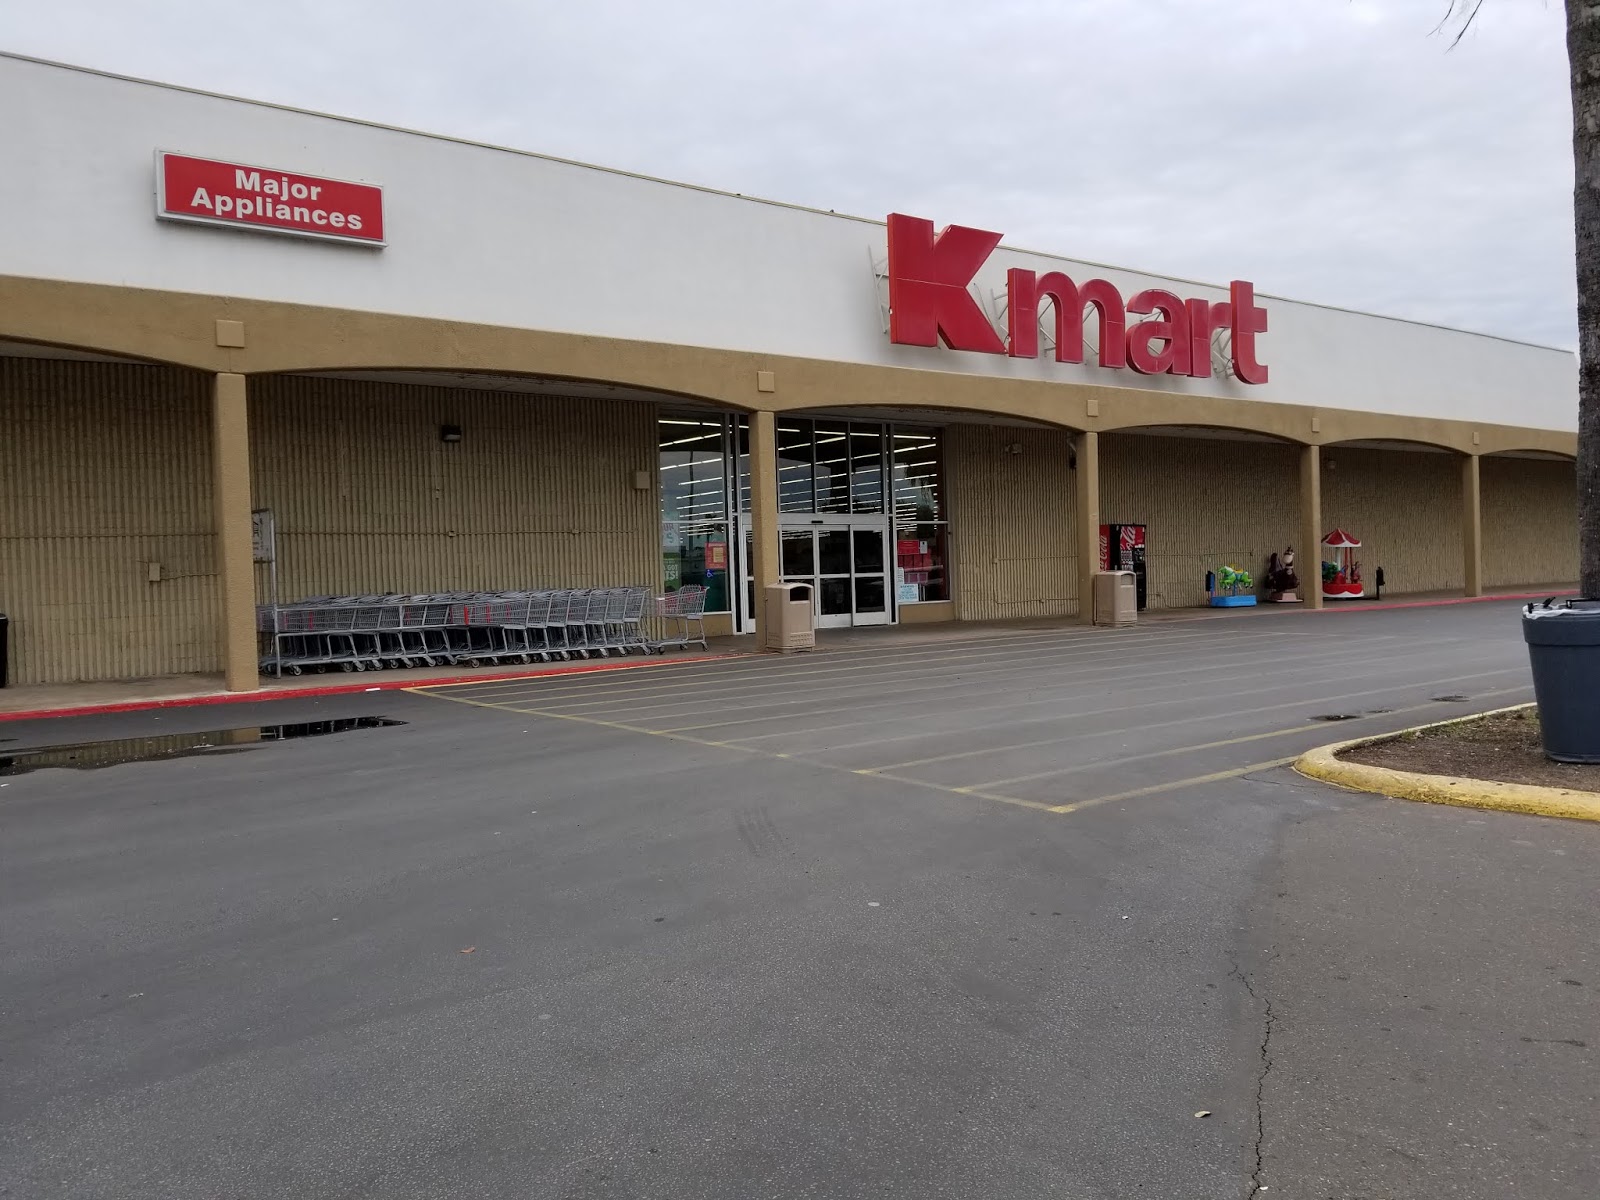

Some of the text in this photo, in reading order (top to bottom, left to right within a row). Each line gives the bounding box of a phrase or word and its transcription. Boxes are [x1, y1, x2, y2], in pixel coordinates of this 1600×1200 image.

[235, 169, 321, 201] Major
[190, 187, 363, 230] Appliances
[887, 212, 1268, 385] Kmart
